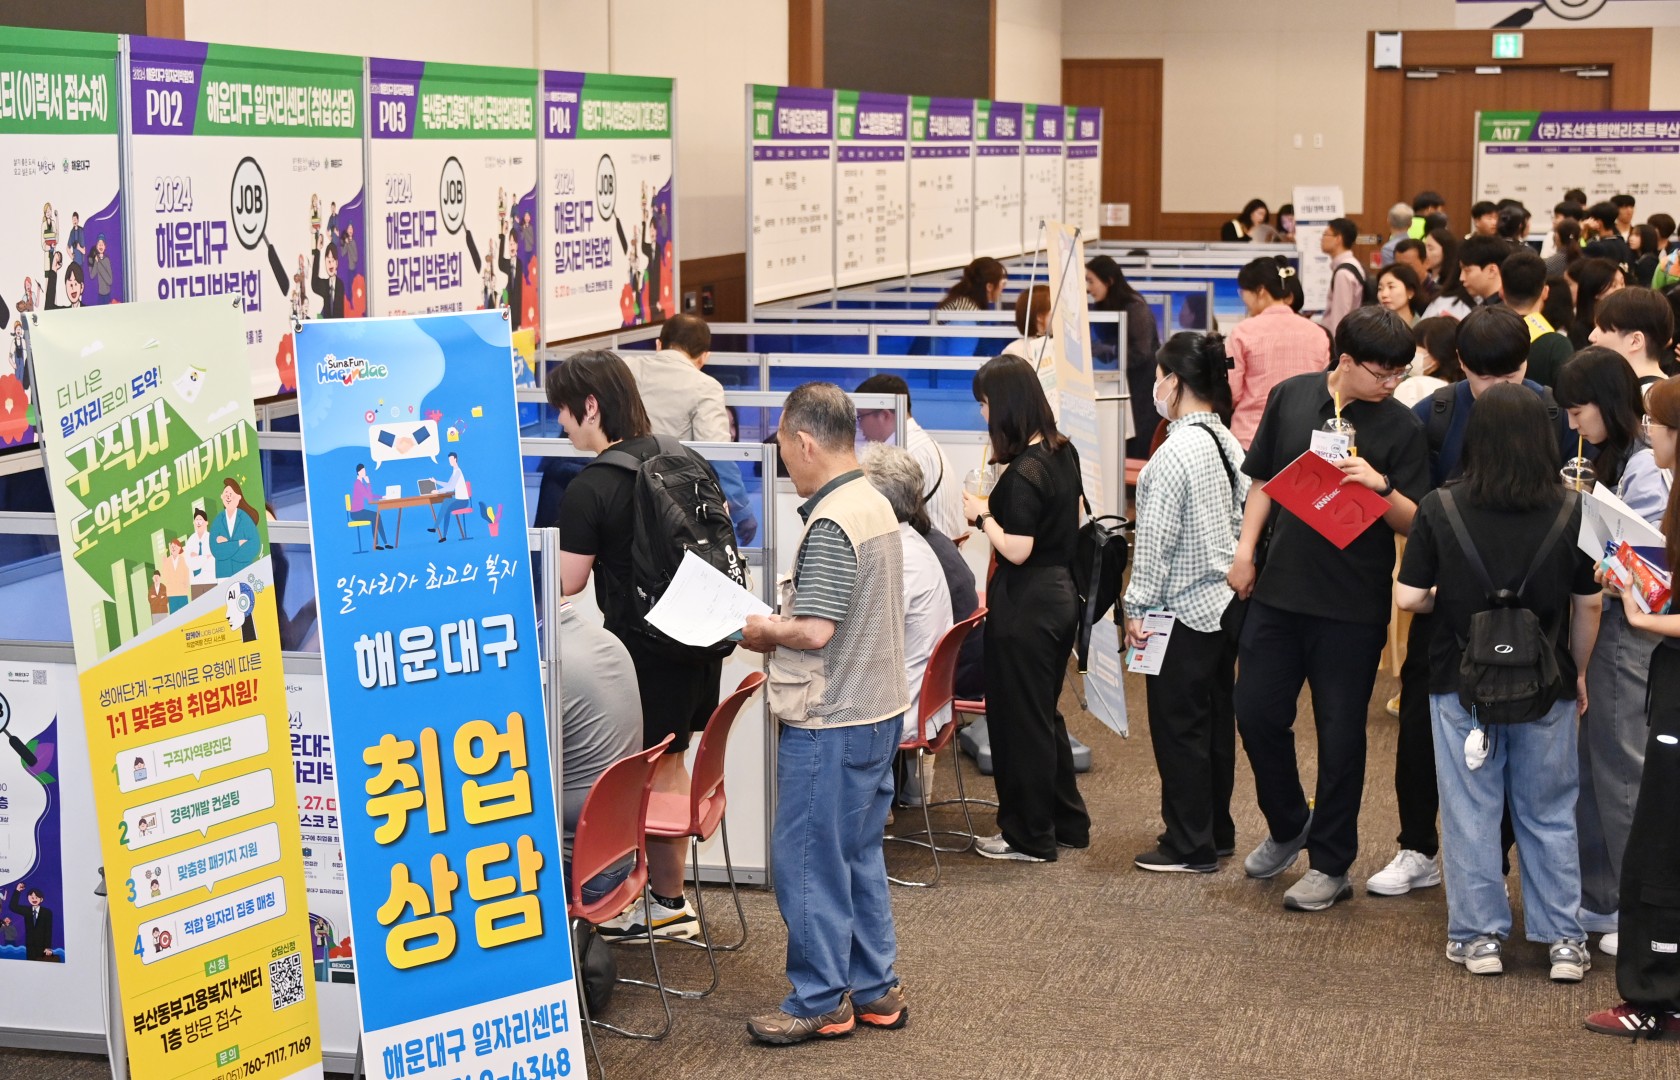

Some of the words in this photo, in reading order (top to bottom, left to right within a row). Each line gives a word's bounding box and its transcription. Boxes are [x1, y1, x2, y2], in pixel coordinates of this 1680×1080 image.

[0, 70, 62, 120] 터(이력서
[65, 73, 107, 121] 접수처)
[146, 89, 183, 127] P02
[206, 81, 253, 125] 해운대구
[254, 84, 355, 128] 일자리센터(취업상담)
[379, 101, 406, 132] P03
[549, 106, 571, 134] P04
[1491, 127, 1520, 140] A07
[155, 176, 193, 213] 2024
[386, 174, 412, 204] 2024
[443, 180, 463, 205] JOB
[554, 168, 575, 195] 2024
[599, 174, 613, 196] JOB
[236, 185, 263, 215] JOB
[555, 200, 594, 234] 해운대구
[155, 220, 228, 269] 해운대구
[386, 210, 437, 250] 해운대구
[555, 236, 612, 275] 일자리박람회
[387, 252, 462, 297] 일자리박람회
[318, 361, 387, 385] Haeundae
[328, 358, 364, 369] Sun&Fun
[57, 387, 71, 409] 더
[75, 368, 103, 401] 나은
[60, 384, 129, 438] 일자리로의
[131, 365, 163, 400] 도약!
[64, 396, 172, 497] 구직자
[70, 464, 171, 560] 도약보장
[174, 418, 249, 496] 패키지
[228, 590, 236, 600] AI
[336, 573, 418, 615] 일자리가
[426, 561, 478, 590] 최고의
[485, 553, 518, 595] 복지
[202, 658, 236, 680] 유형에
[238, 652, 262, 673] 따른
[353, 613, 518, 690] 해운대구
[106, 712, 128, 739] 1:1
[131, 696, 184, 733] 맞춤형
[187, 678, 259, 718] 취업지원!
[163, 736, 232, 768] 구직자역량진단
[362, 711, 533, 845] 취업
[170, 800, 210, 824] 경력개발
[212, 790, 240, 812] 컨설팅
[298, 814, 324, 828] 스코
[118, 820, 130, 845] 2
[177, 860, 207, 881] 맞춤형
[208, 850, 237, 873] 패키지
[239, 841, 258, 861] 지원
[125, 878, 137, 903] 3
[376, 834, 543, 970] 상담
[184, 918, 204, 936] 적합
[205, 906, 235, 930] 일자리
[236, 899, 255, 921] 집중
[256, 891, 276, 913] 매칭
[133, 934, 145, 958] 4
[271, 941, 296, 958] 상담신청
[208, 958, 226, 974] 신청
[133, 967, 263, 1035] 부산동부고용복지+센터
[160, 1027, 183, 1054] 1층
[185, 1012, 214, 1044] 방문
[216, 1004, 243, 1031] 접수
[383, 1028, 466, 1080] 해운대구
[473, 1000, 569, 1057] 일자리센터
[219, 1047, 237, 1065] 문의
[288, 1036, 311, 1057] 7169
